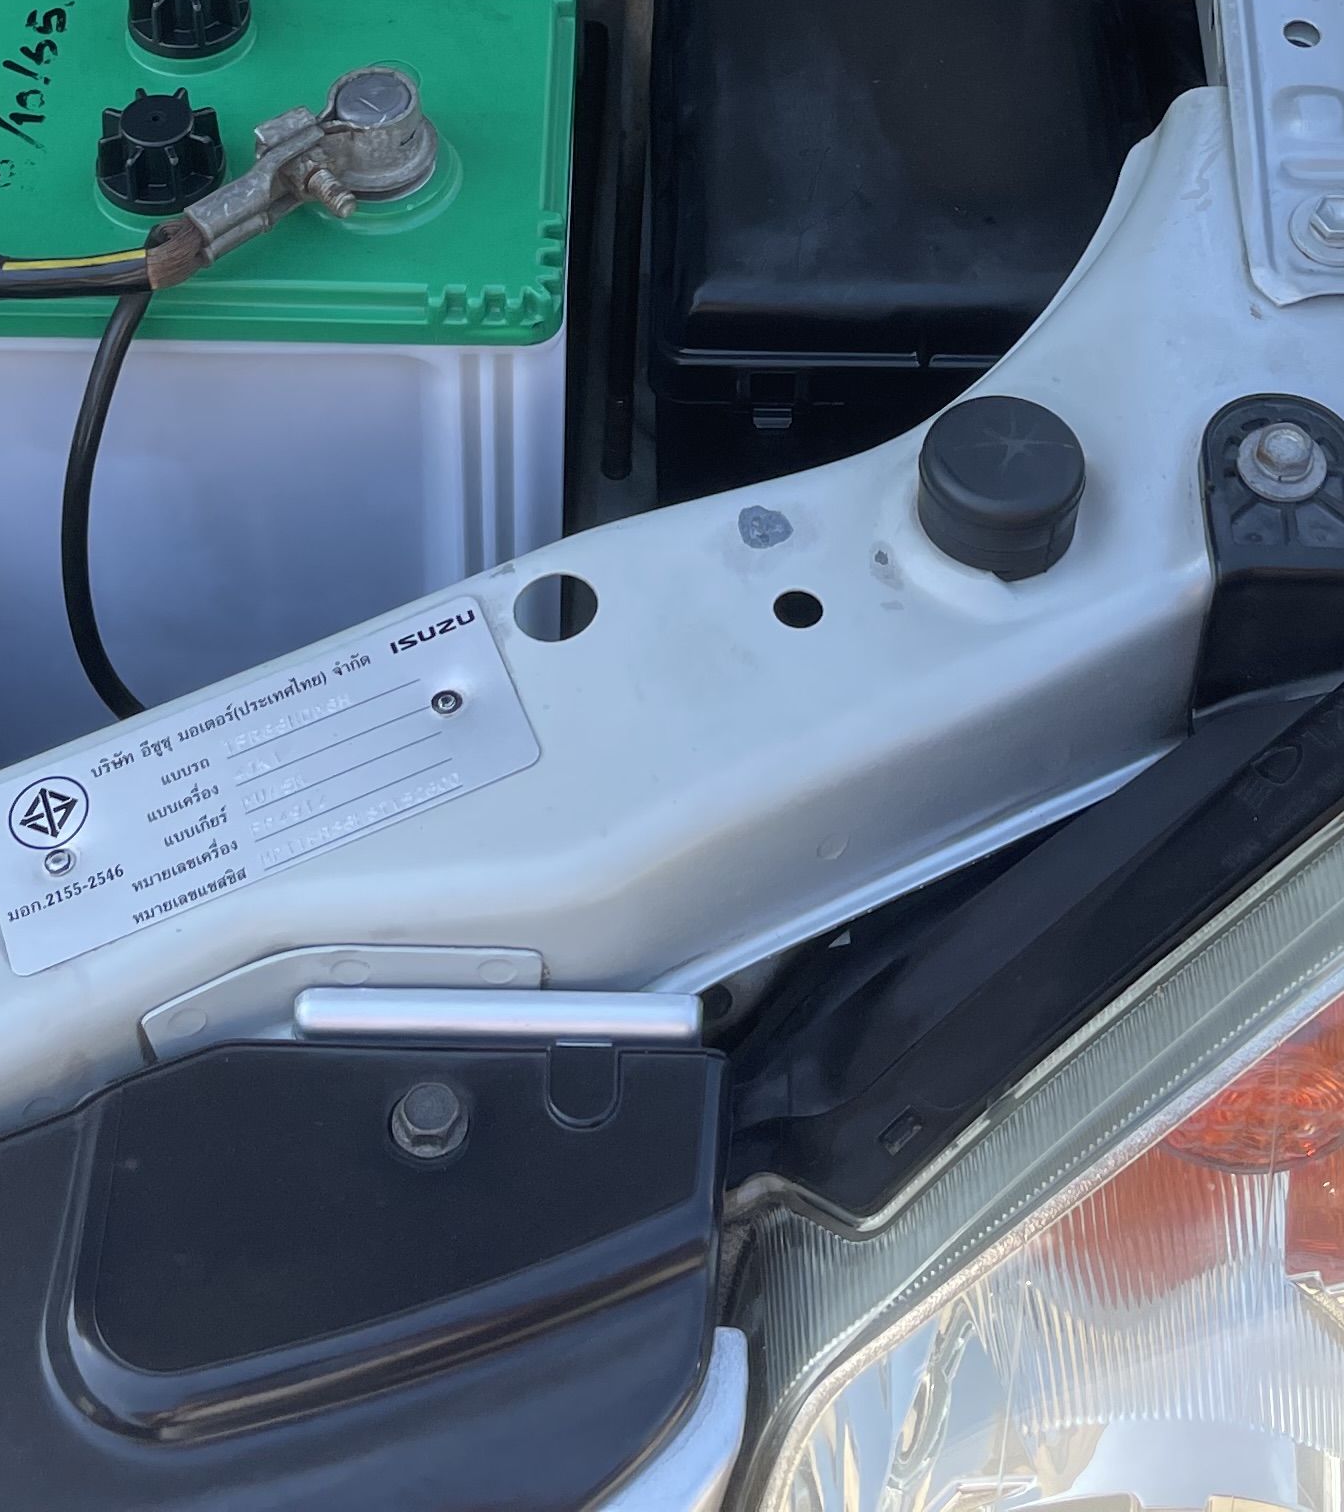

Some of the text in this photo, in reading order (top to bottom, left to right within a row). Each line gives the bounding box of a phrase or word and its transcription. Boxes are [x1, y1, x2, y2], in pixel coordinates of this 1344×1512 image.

[389, 609, 476, 655] ISUZU
[90, 653, 372, 779] บริษัท อีซูซุ มอเตอร์(ประเทศไทย) จำกัด
[161, 757, 211, 786] แบบรถ
[147, 781, 220, 823] แบบเครื่อง
[163, 805, 229, 847] แบบเกียร์
[131, 838, 239, 892] หมายเลขเครื่อง
[8, 864, 124, 922] มอก.2155-2546
